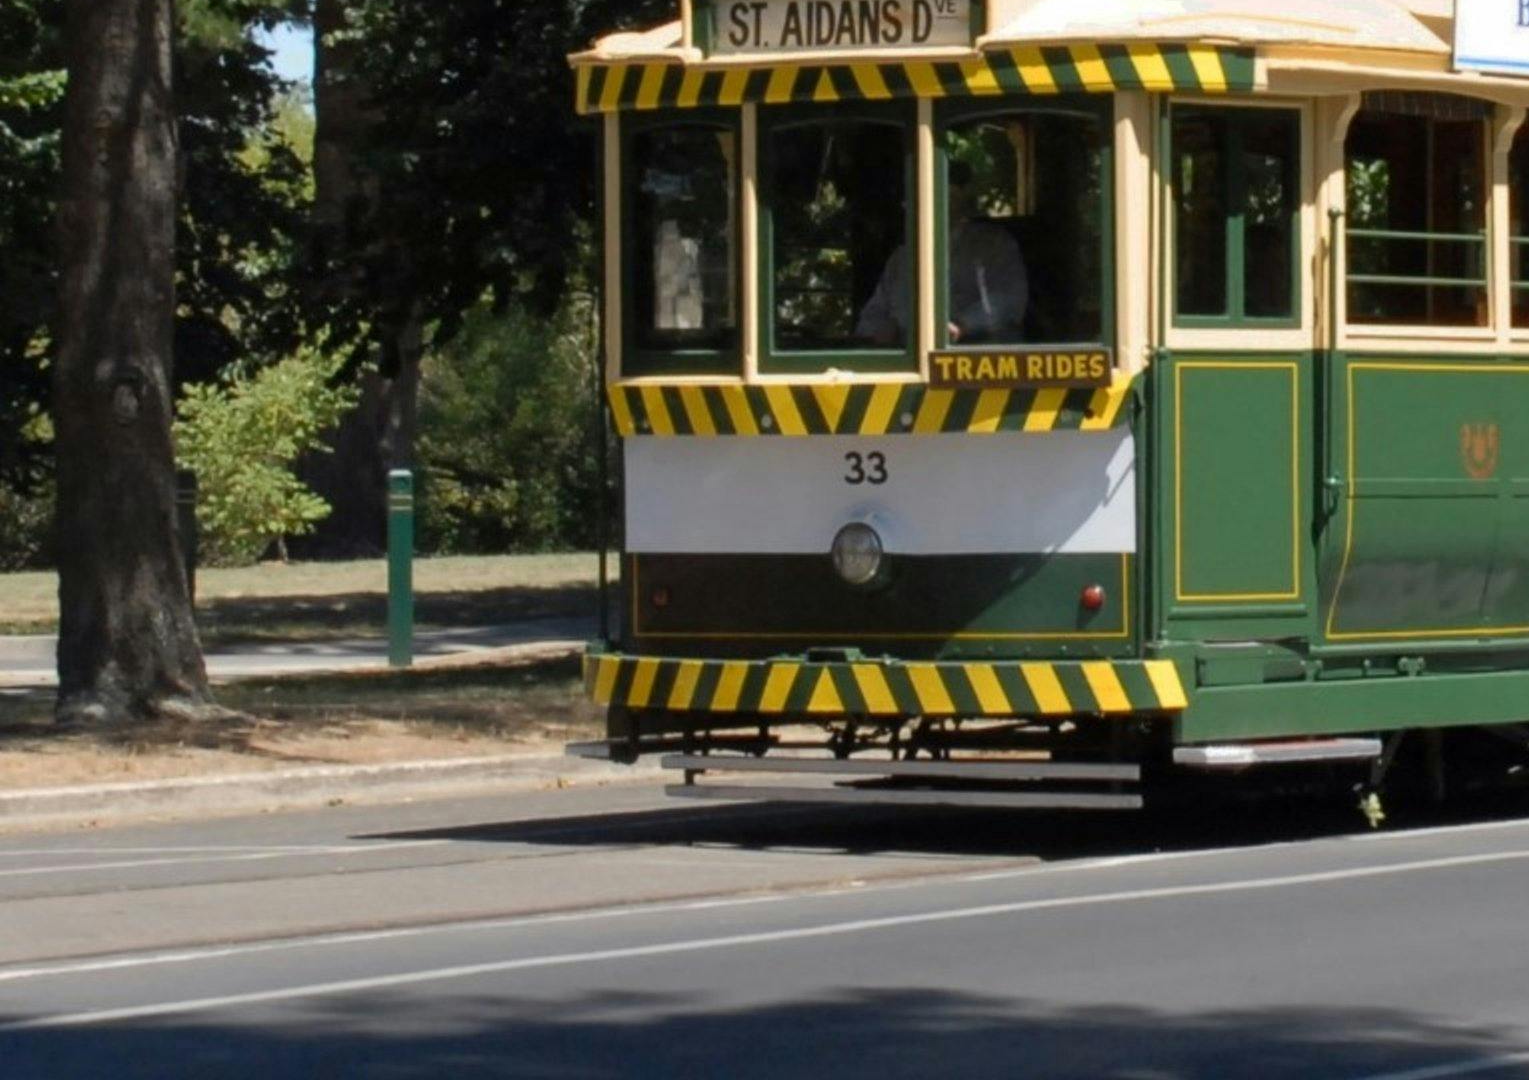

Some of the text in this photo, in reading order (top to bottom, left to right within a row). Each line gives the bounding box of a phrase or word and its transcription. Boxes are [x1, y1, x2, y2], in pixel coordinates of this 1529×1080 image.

[728, 1, 769, 48] ST.
[935, 353, 1105, 381] TRAM RIDES
[844, 450, 889, 485] 33
